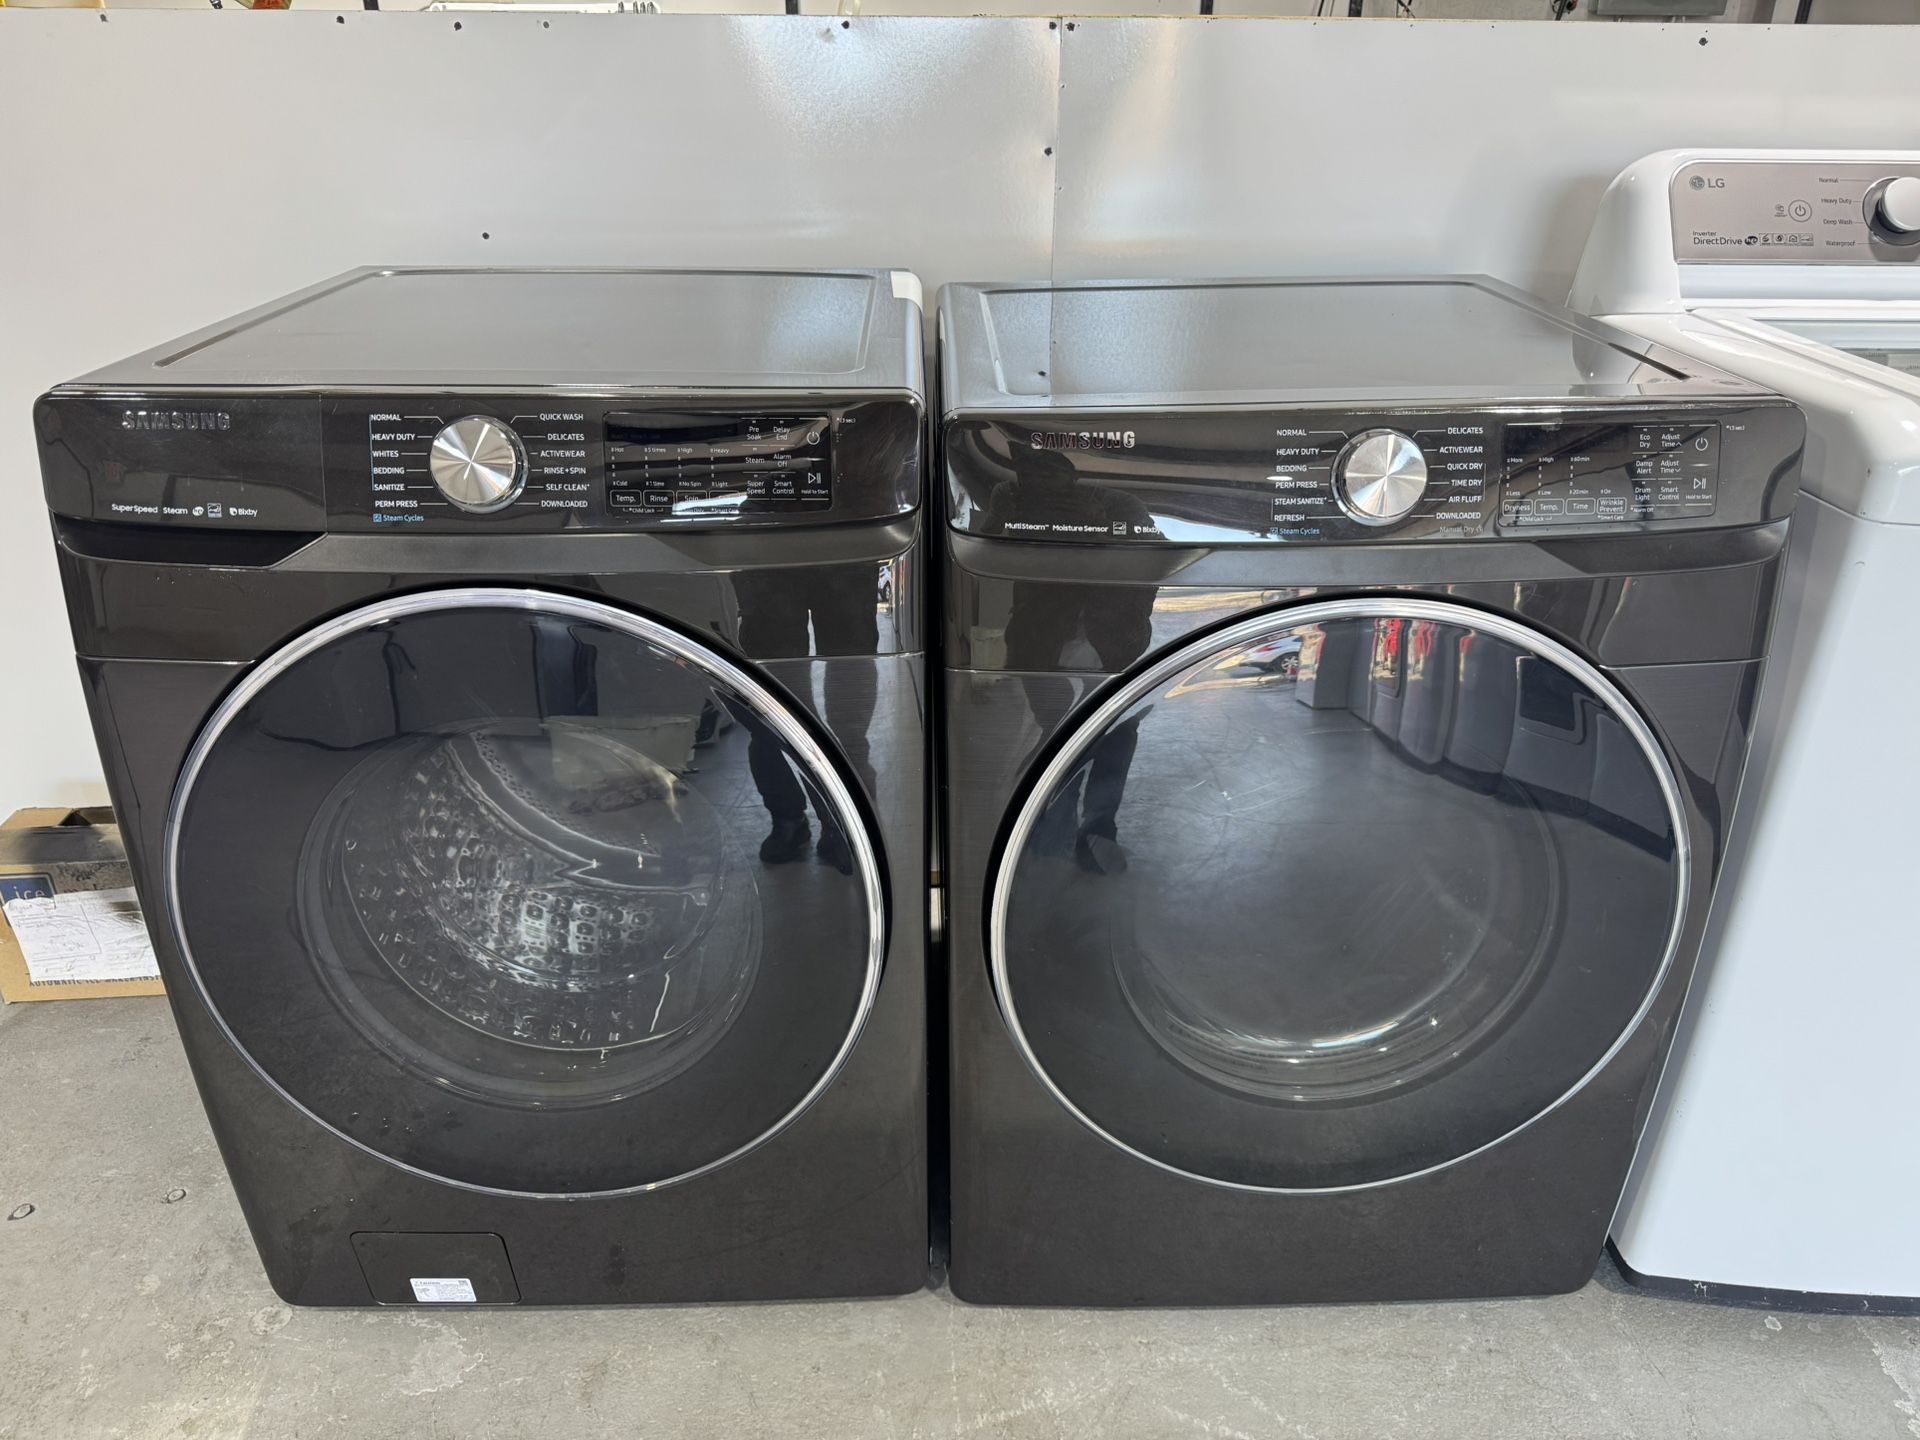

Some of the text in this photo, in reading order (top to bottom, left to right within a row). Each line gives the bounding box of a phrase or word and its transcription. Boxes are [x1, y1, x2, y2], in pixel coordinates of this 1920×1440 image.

[1708, 178, 1725, 188] LG
[122, 411, 232, 430] SAMSUNG
[1031, 431, 1136, 449] SAMSUNG
[238, 508, 258, 517] Bixby
[404, 514, 424, 522] Cycles
